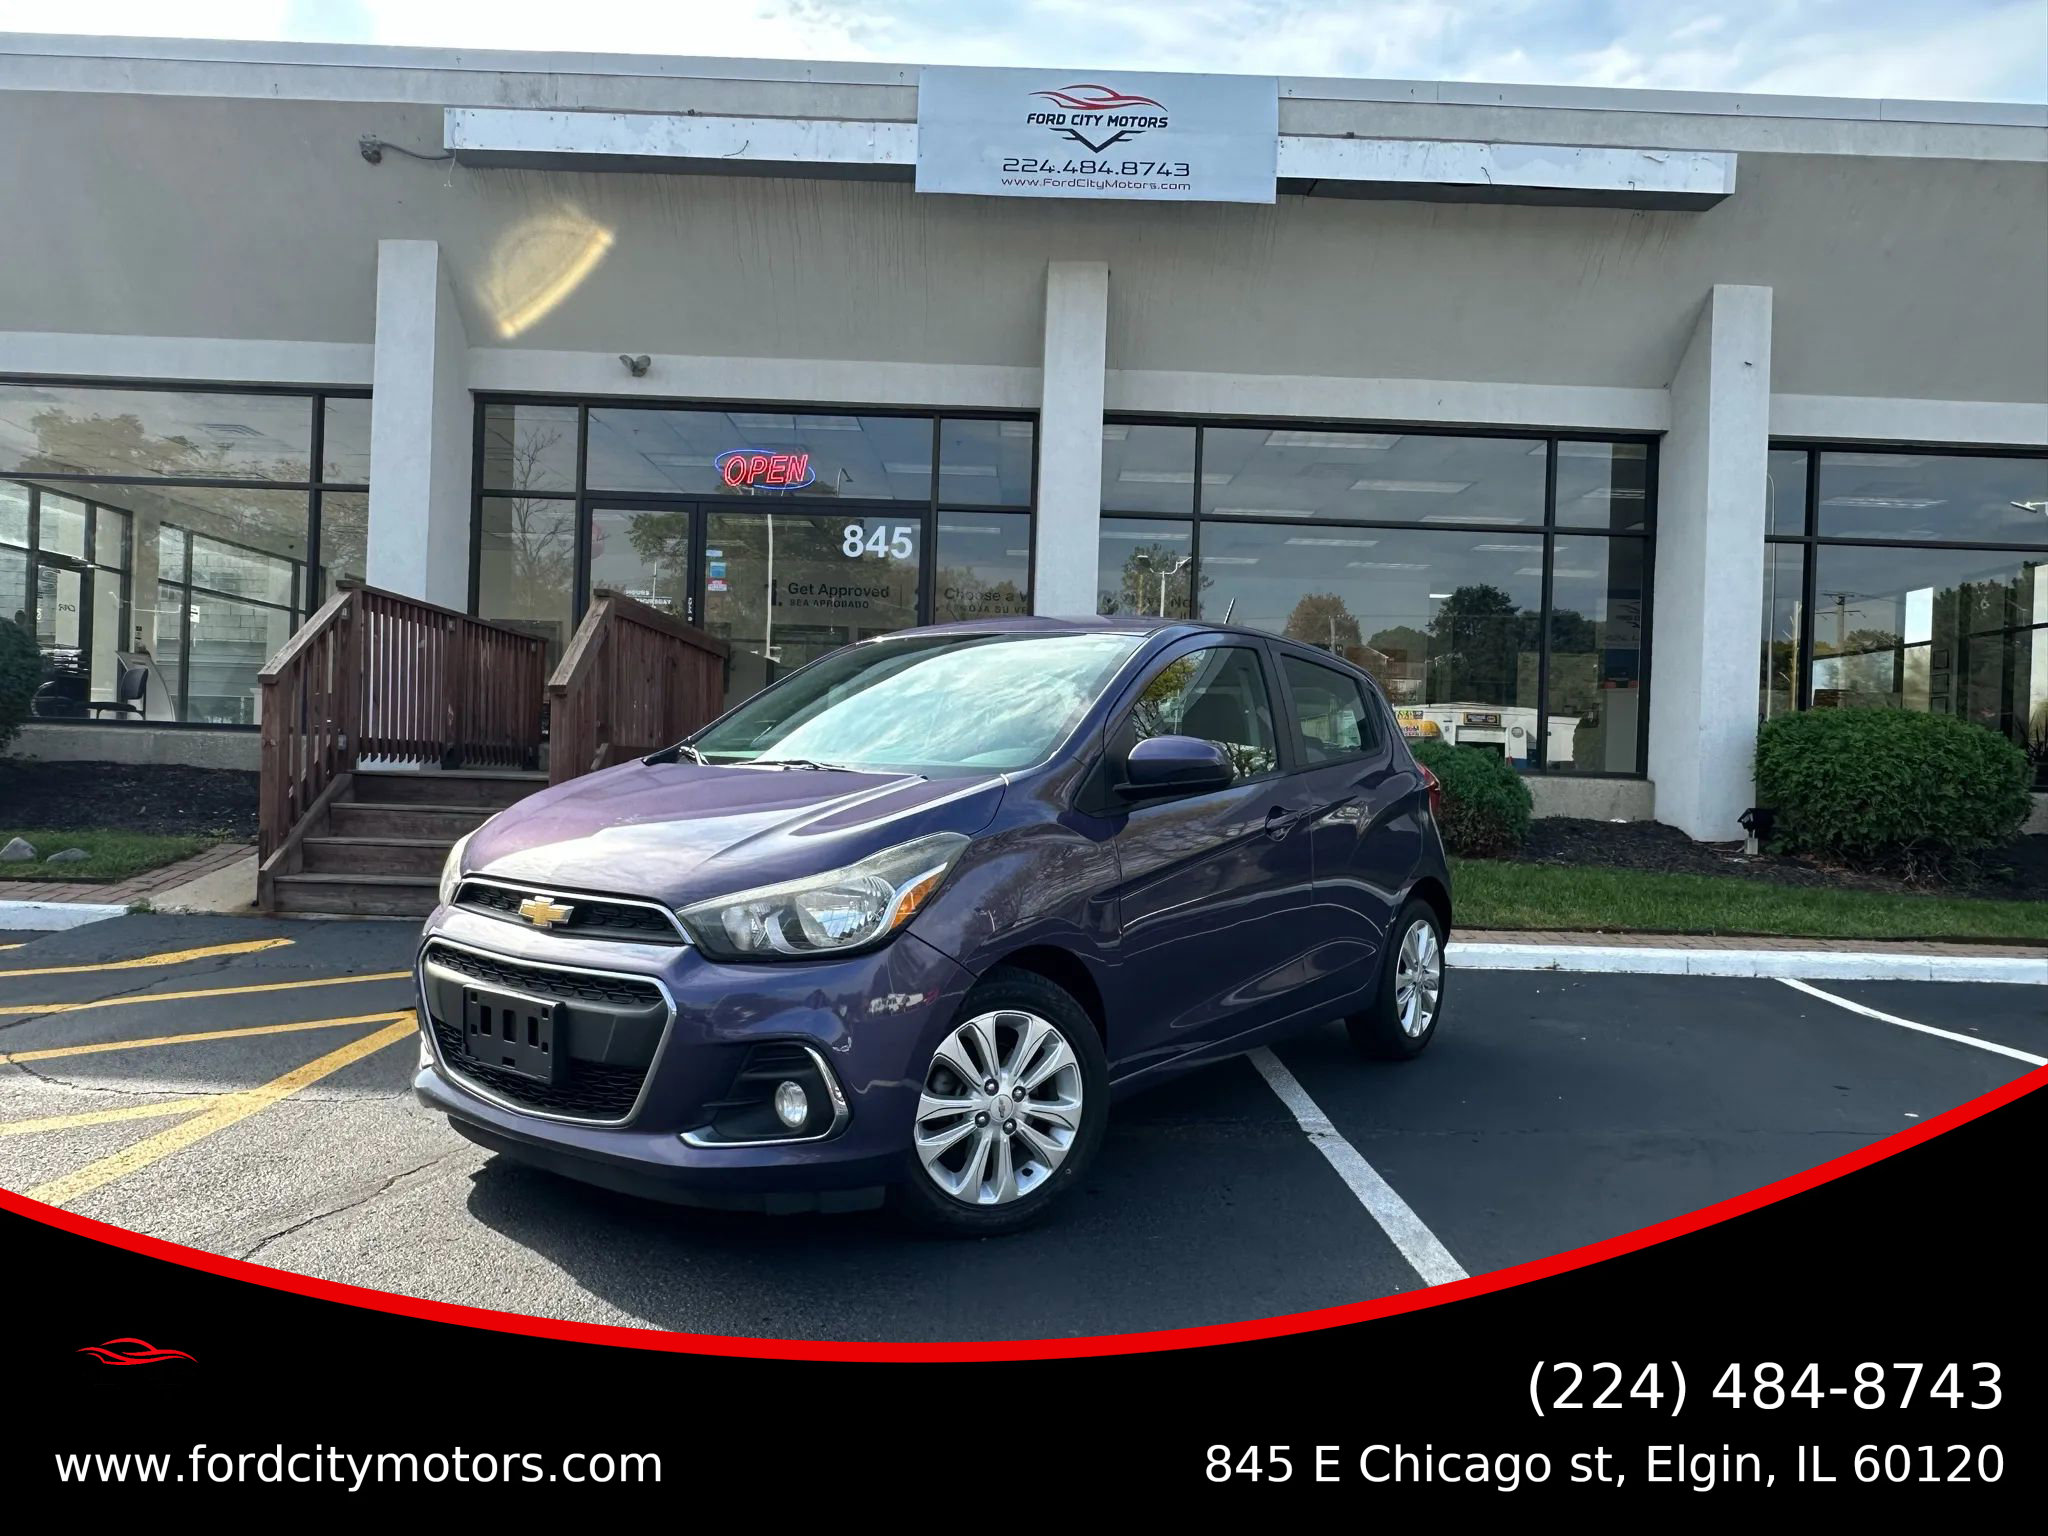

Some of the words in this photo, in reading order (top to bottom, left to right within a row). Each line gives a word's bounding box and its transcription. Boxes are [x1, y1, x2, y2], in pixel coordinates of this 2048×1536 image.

[1026, 112, 1066, 126] FORD
[1070, 114, 1104, 127] CITY
[1107, 115, 1169, 129] MOTORS
[1002, 157, 1191, 177] 224.484.8743
[1001, 176, 1192, 192] www.FordCityMotors.com
[724, 454, 809, 487] OPEN
[842, 524, 913, 559] 845
[788, 581, 814, 596] Get
[818, 582, 890, 599] Approved
[944, 587, 1002, 602] Choose
[812, 598, 870, 610] APROBADO
